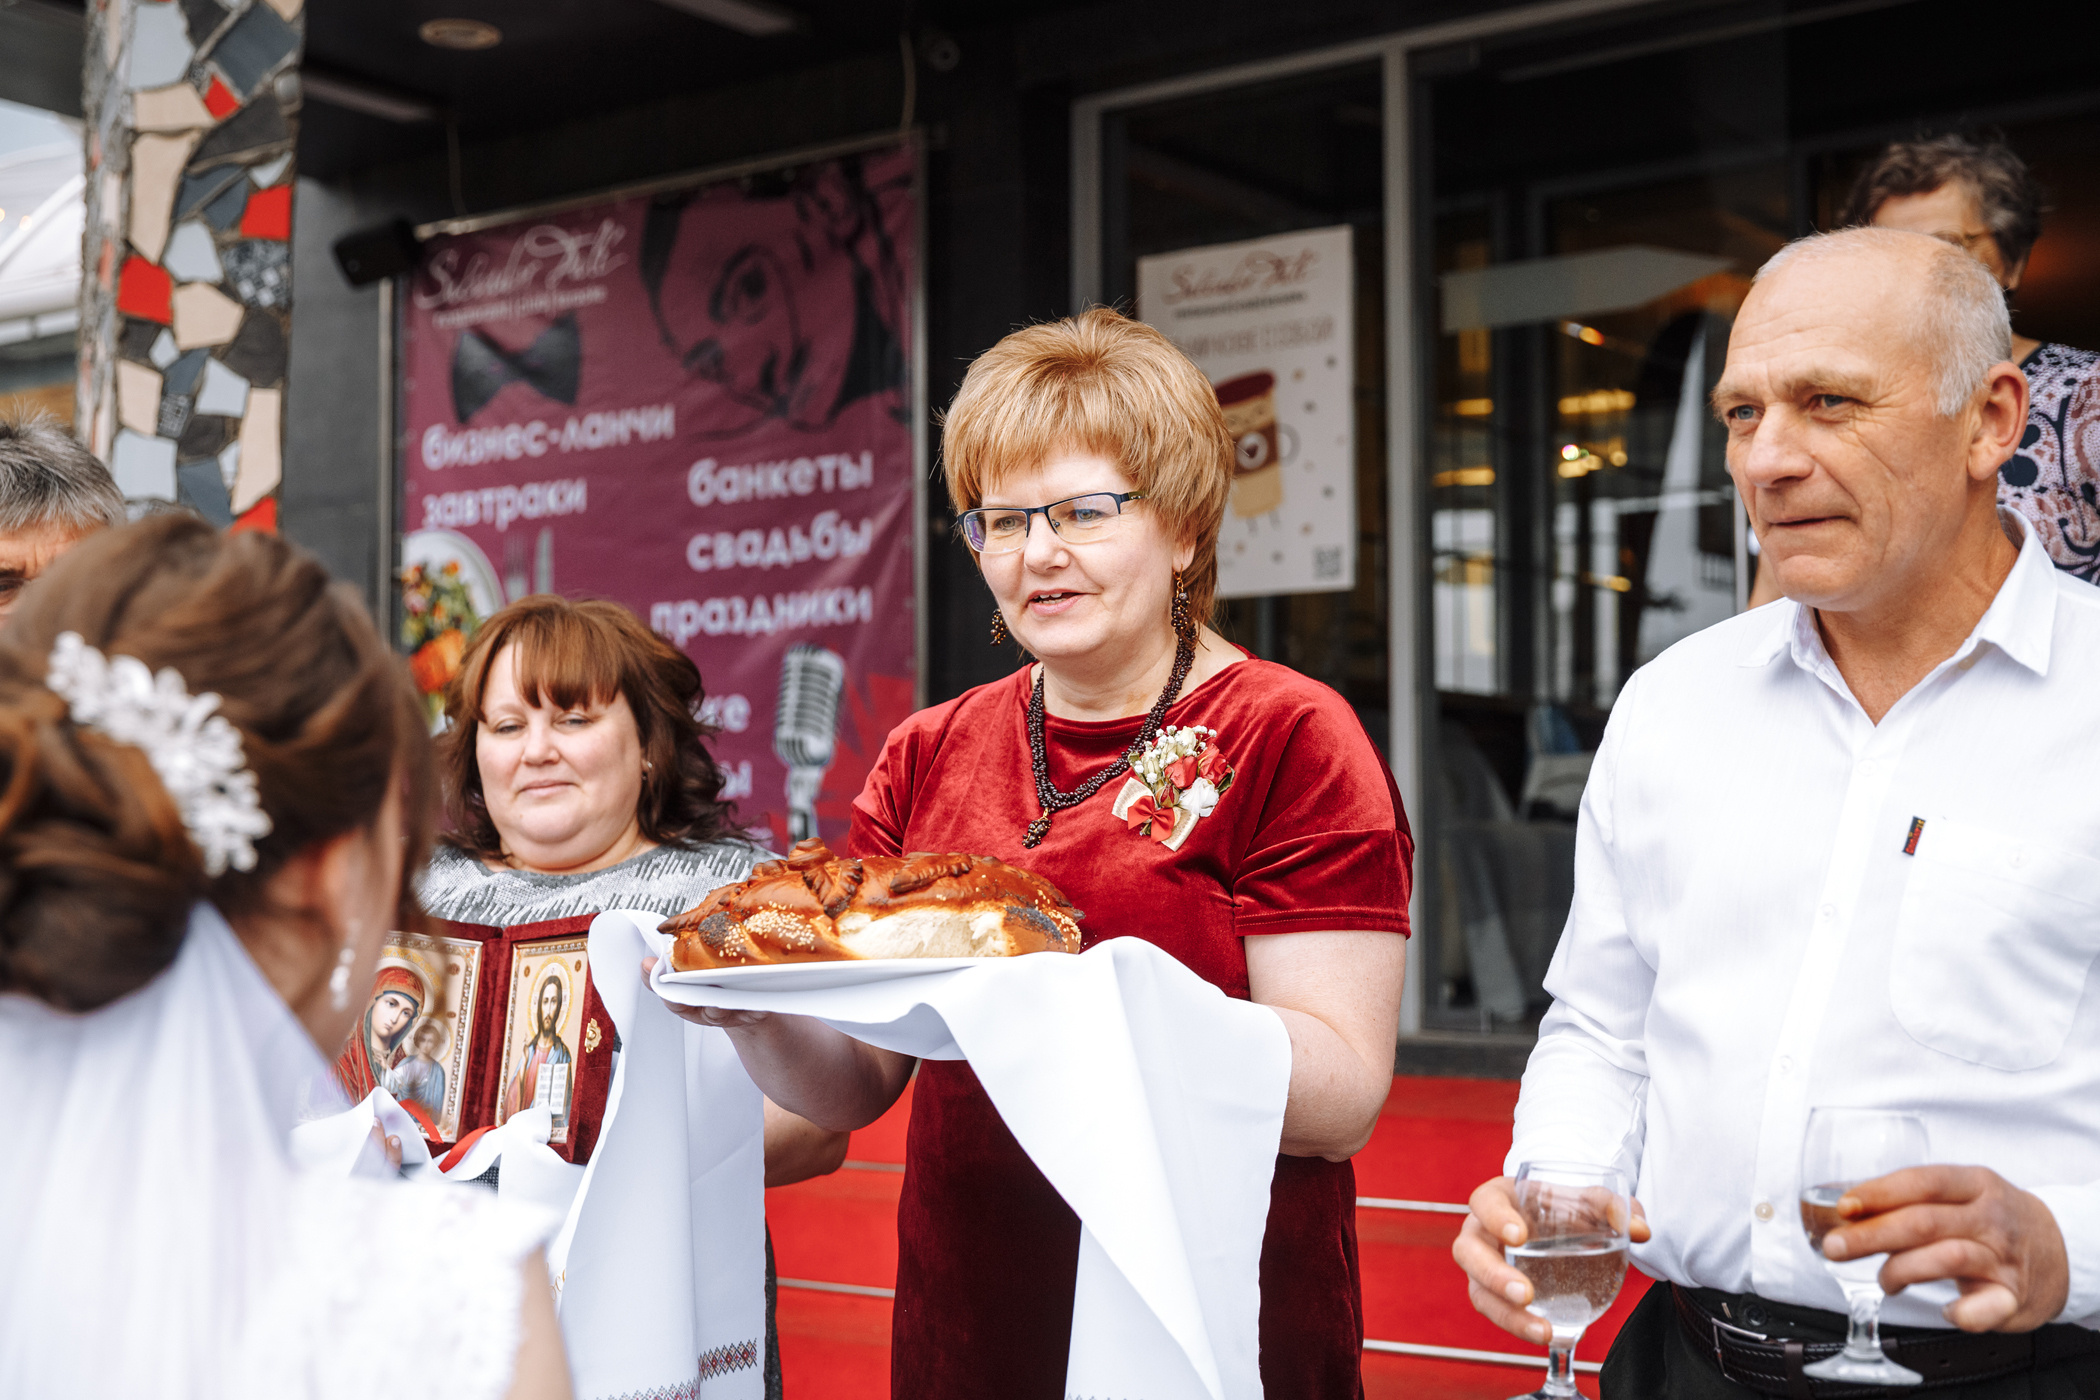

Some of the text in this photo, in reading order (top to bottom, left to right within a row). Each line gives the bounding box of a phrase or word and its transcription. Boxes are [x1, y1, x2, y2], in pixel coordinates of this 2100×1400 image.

[421, 405, 677, 471] бизнес-ланчи
[421, 478, 588, 530] завтраки
[687, 451, 875, 507] банкеты
[687, 510, 874, 572] свадьбы
[650, 586, 875, 648] праздники
